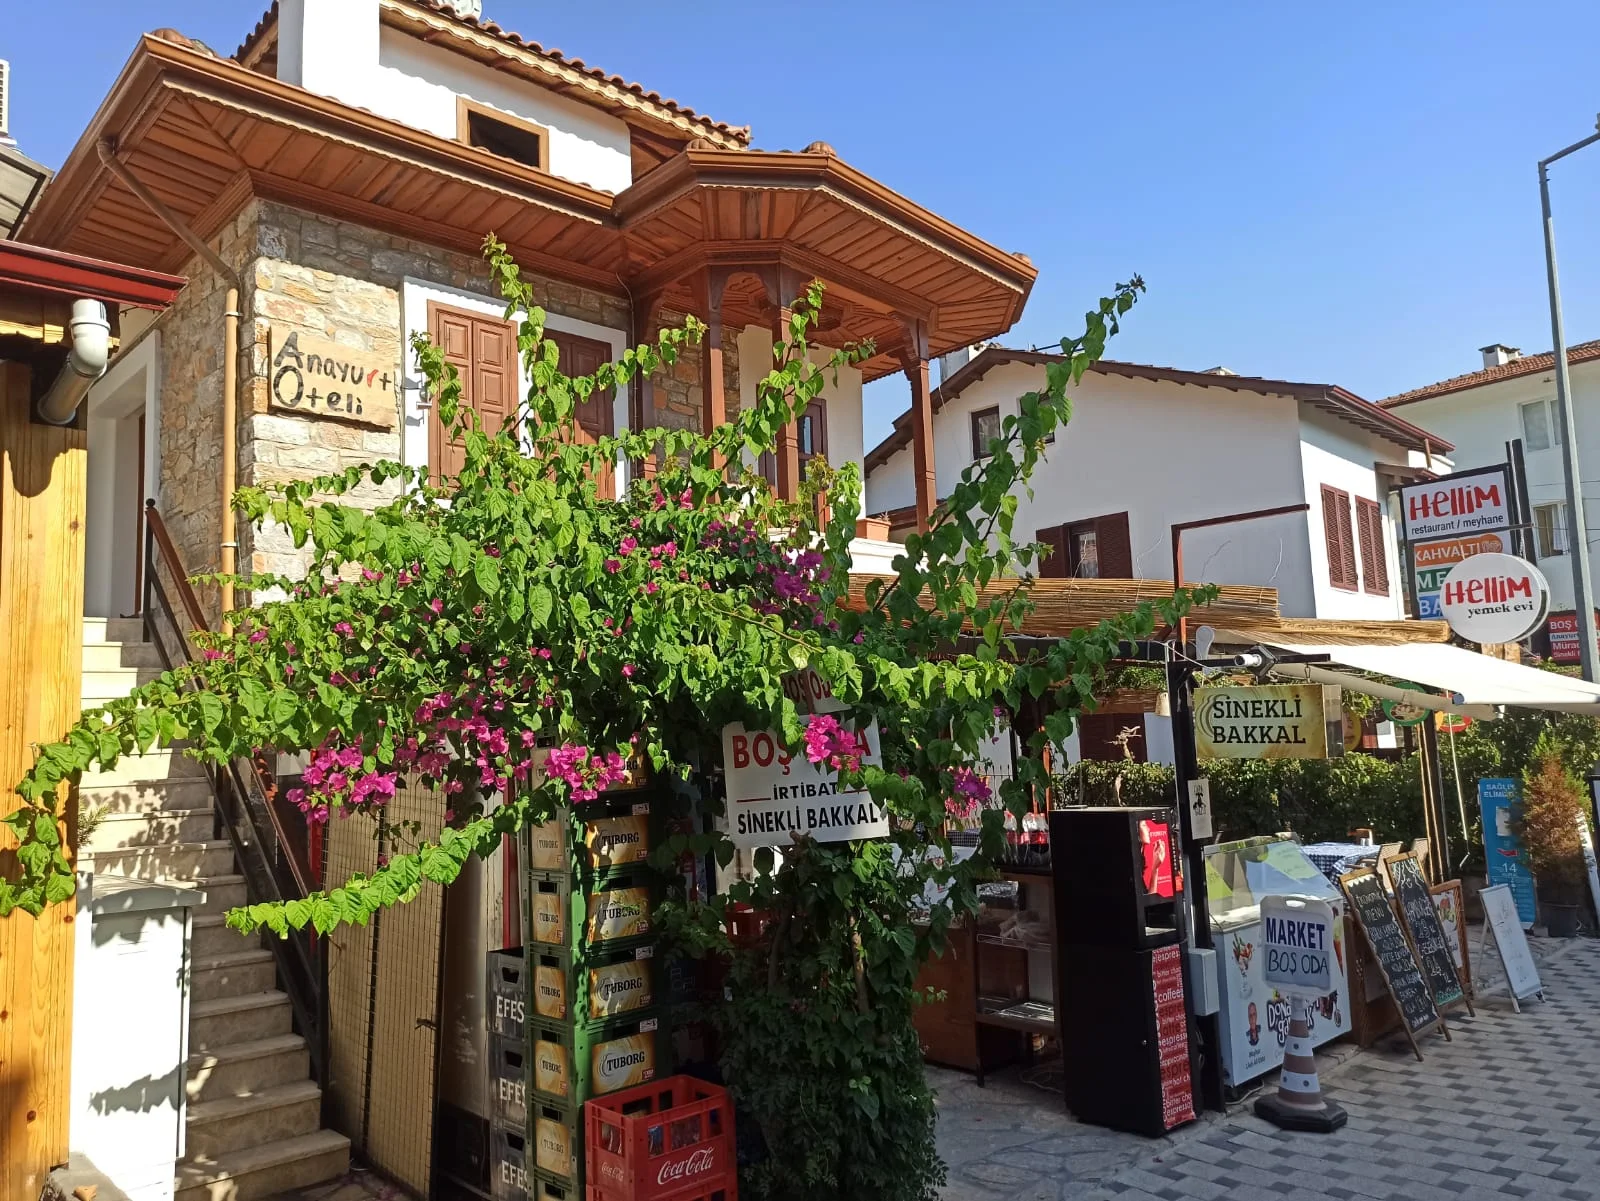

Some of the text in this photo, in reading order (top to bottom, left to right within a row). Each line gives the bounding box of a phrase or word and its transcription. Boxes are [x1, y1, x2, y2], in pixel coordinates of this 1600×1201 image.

[273, 365, 363, 415] Oteli
[1412, 521, 1455, 535] restaurant
[1463, 515, 1504, 529] meyhane
[1468, 601, 1533, 618] yemek evi
[1213, 694, 1302, 719] SİNEKLİ
[1212, 725, 1306, 744] BAKKAL
[737, 802, 878, 835] SİNEKLİ BAKKAL
[601, 831, 639, 846] TUBORG
[1266, 917, 1326, 951] MARKET
[1301, 954, 1330, 977] ODA
[540, 985, 561, 998] TUBORG
[604, 978, 643, 996] TUBORG
[496, 995, 525, 1023] EFES
[606, 1051, 646, 1072] TUBORG
